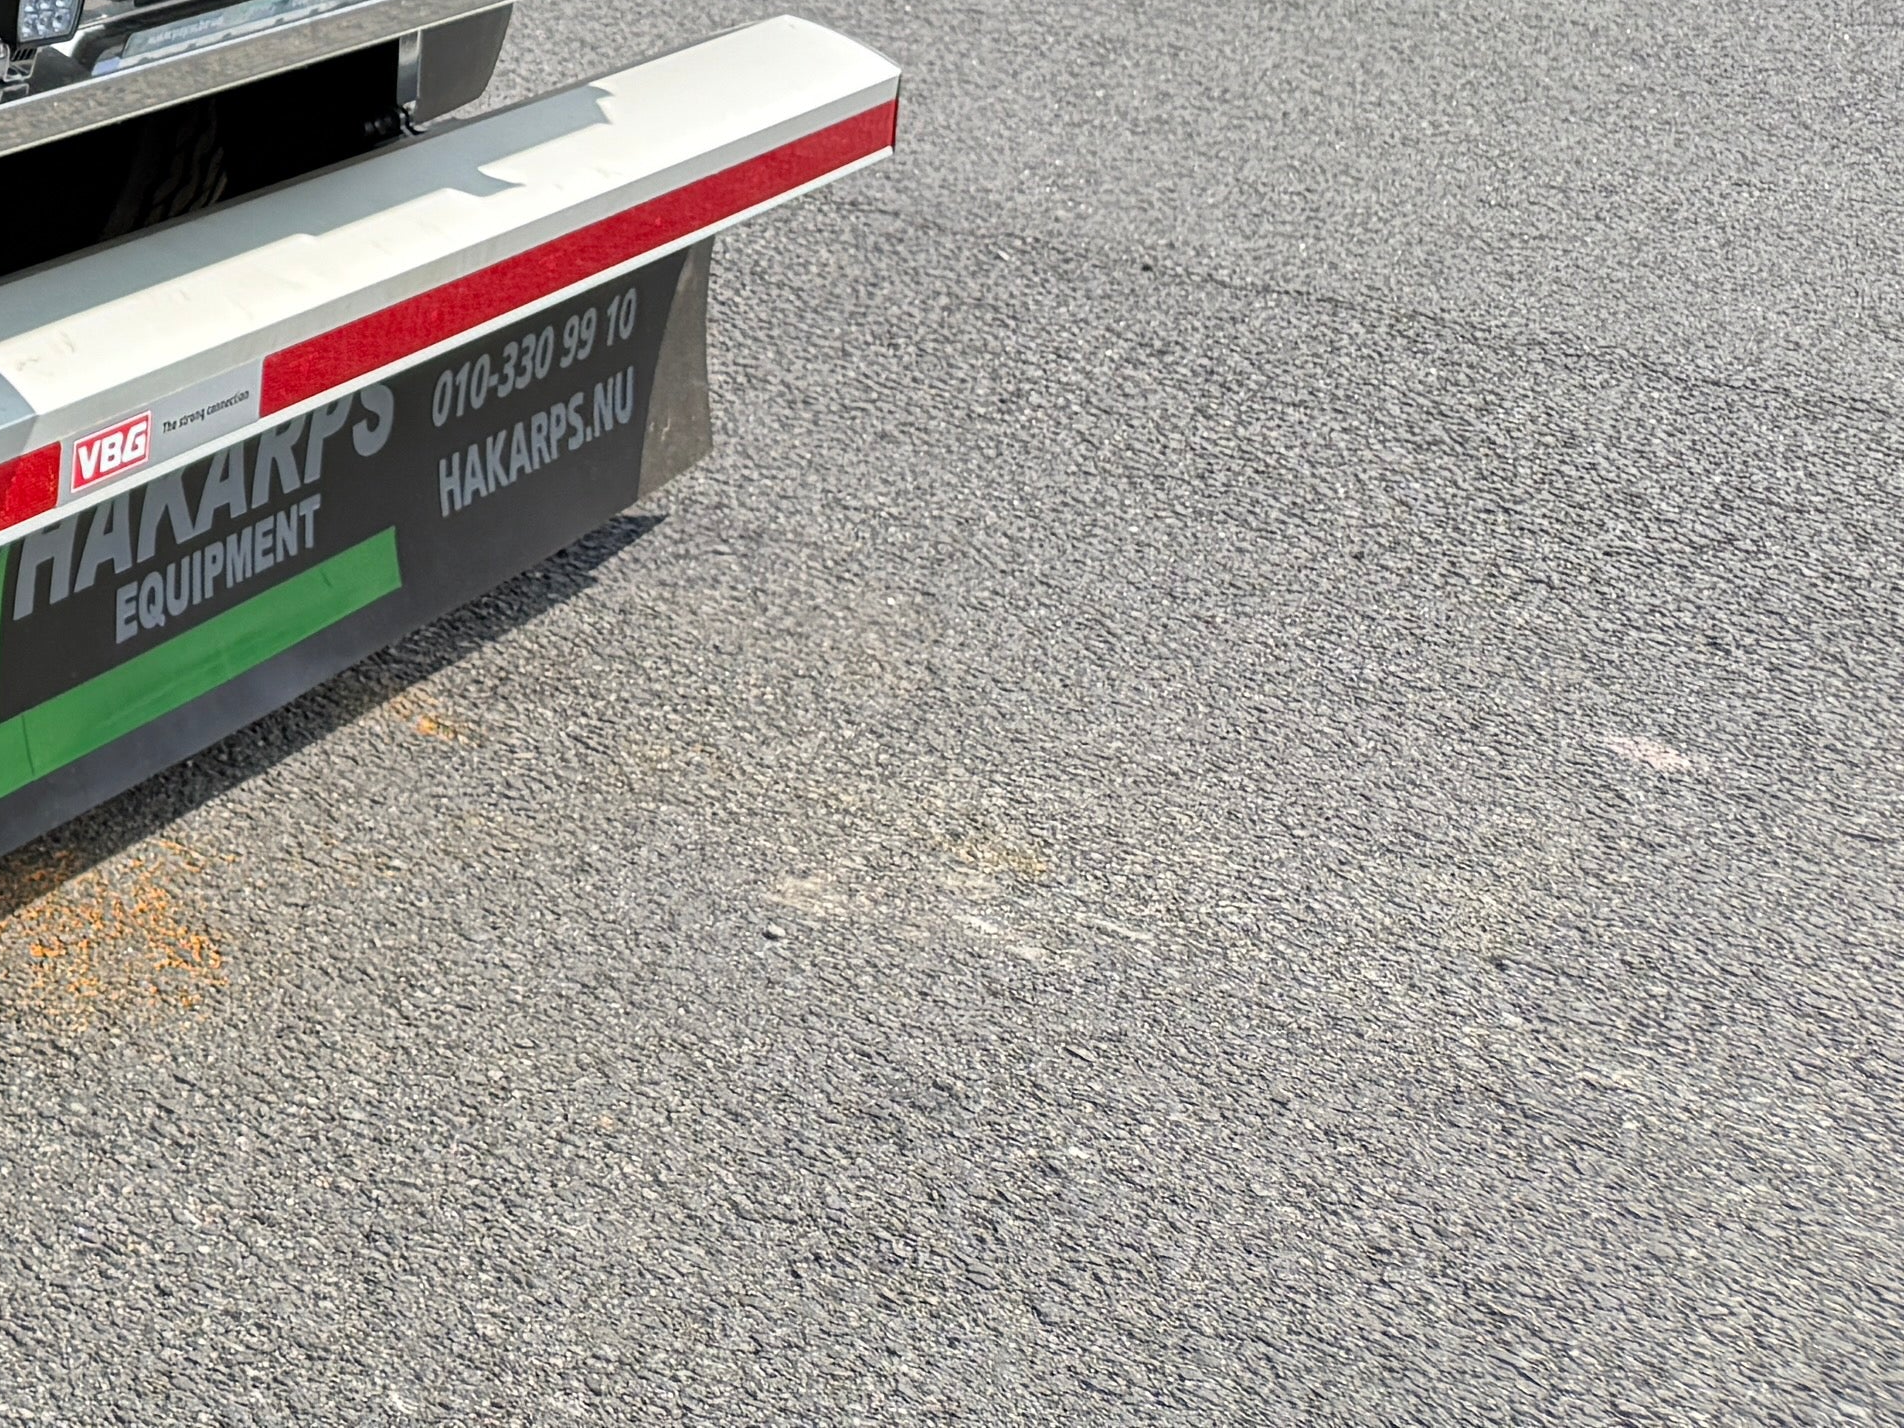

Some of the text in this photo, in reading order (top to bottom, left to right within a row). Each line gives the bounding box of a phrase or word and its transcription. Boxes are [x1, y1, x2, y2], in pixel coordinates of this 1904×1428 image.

[431, 288, 637, 427] 010-330 99 10
[77, 390, 250, 481] VBG The strong connection
[438, 365, 635, 518] HAKARPS.NU
[116, 493, 322, 644] EQUIPMENT
